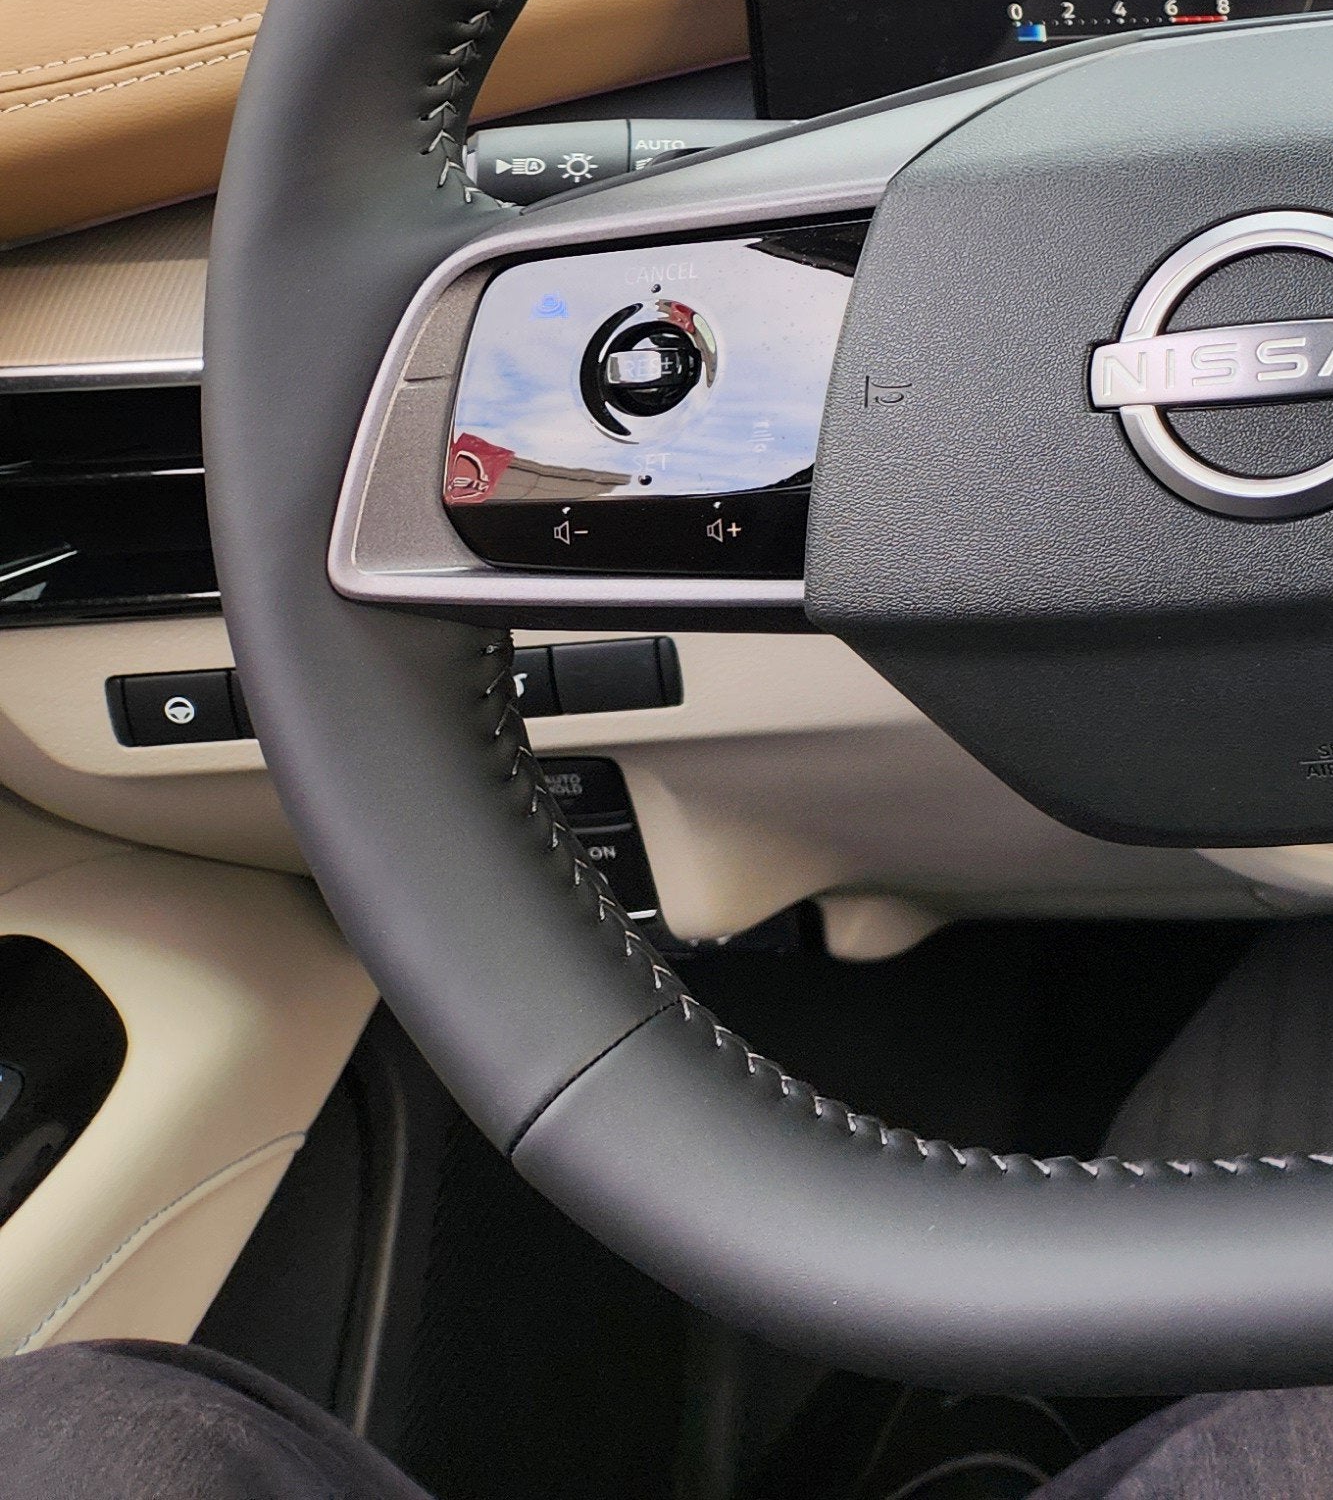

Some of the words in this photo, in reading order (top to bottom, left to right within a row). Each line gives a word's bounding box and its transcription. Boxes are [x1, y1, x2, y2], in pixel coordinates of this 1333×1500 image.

[1007, 3, 1023, 20] 0
[1062, 1, 1076, 19] 2
[1112, 0, 1127, 17] 4
[1164, 0, 1178, 15] 6
[634, 139, 686, 150] AUTO
[625, 262, 698, 285] CANCEL
[632, 453, 672, 473] SET
[589, 846, 616, 861] ON
